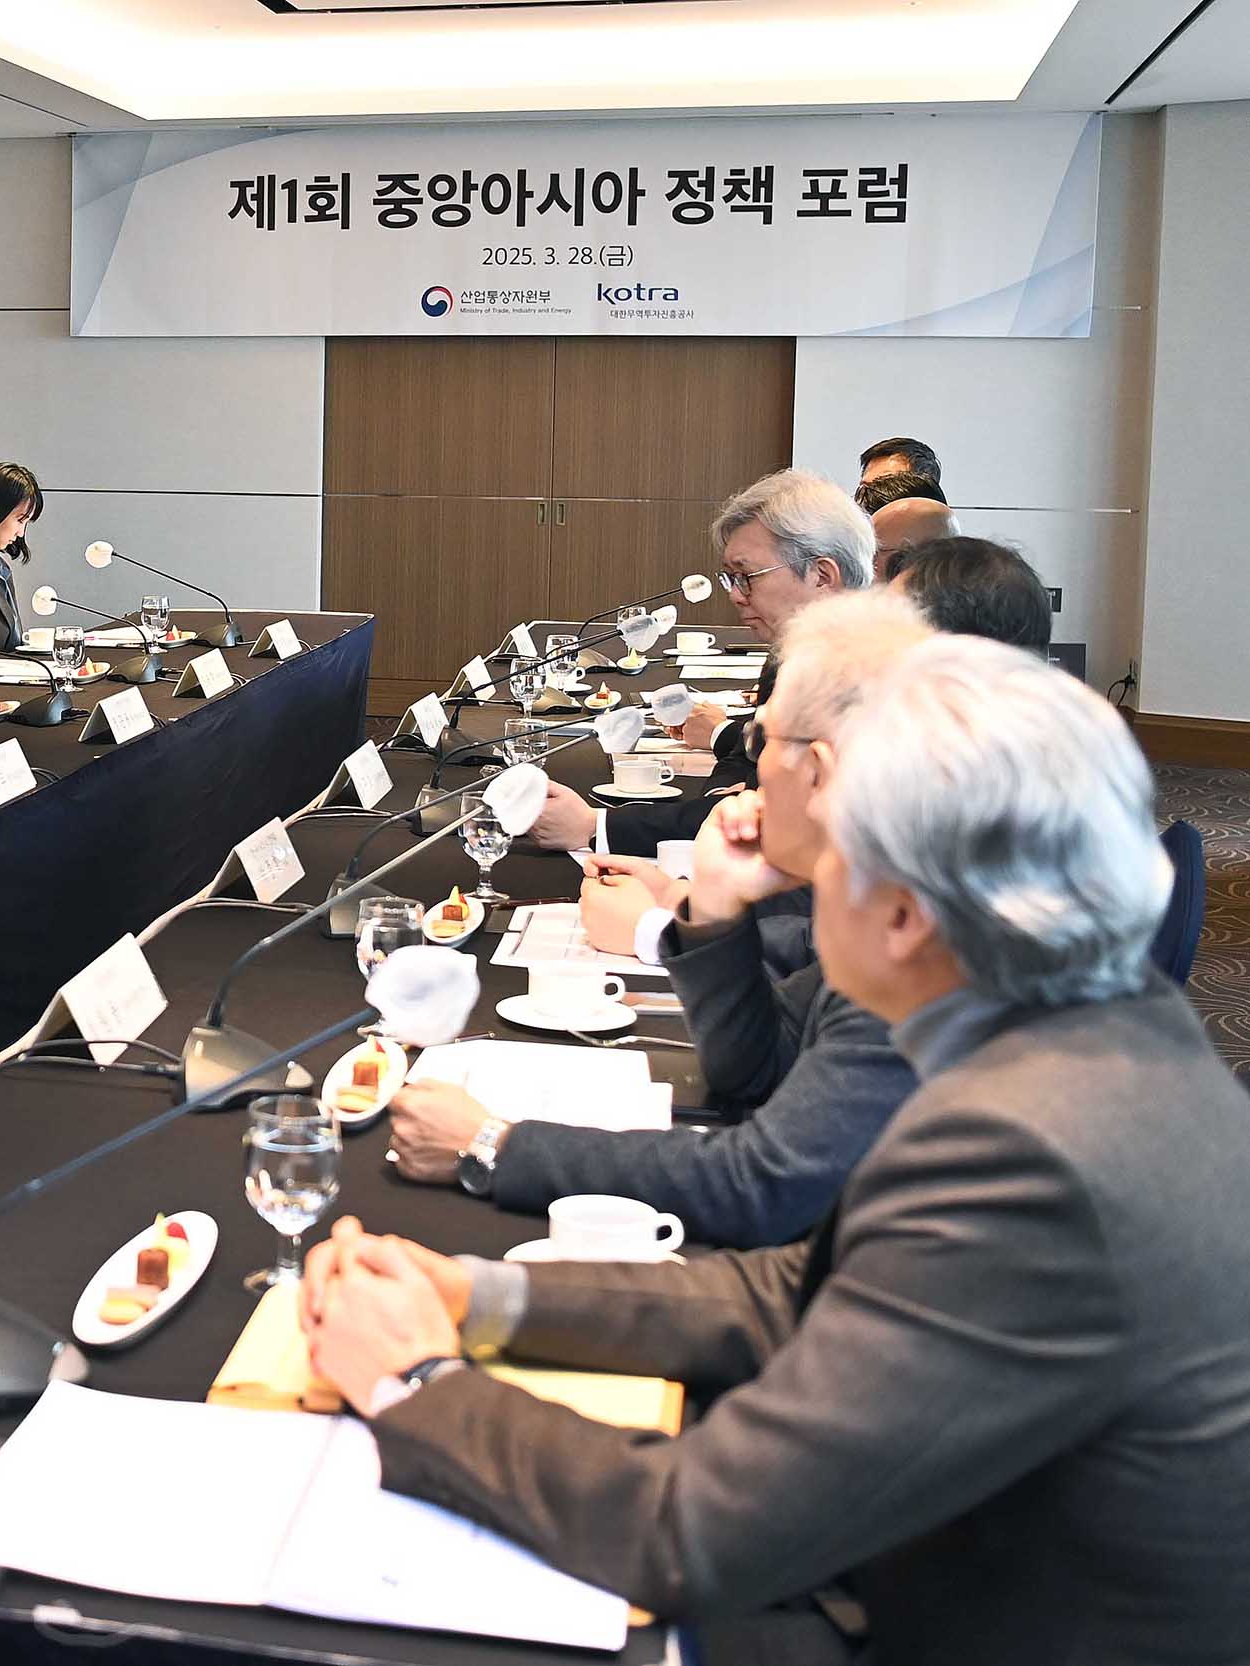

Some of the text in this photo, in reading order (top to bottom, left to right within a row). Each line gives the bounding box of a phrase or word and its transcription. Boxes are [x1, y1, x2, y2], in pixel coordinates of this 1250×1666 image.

[227, 163, 909, 231] 제1회 중앙아시아 정책 포럼
[481, 244, 634, 267] 2025. 3. 28.(금)
[460, 290, 551, 304] 산업통상자원부
[597, 282, 679, 306] kotra
[609, 309, 694, 320] 대한무역투자진흥공사
